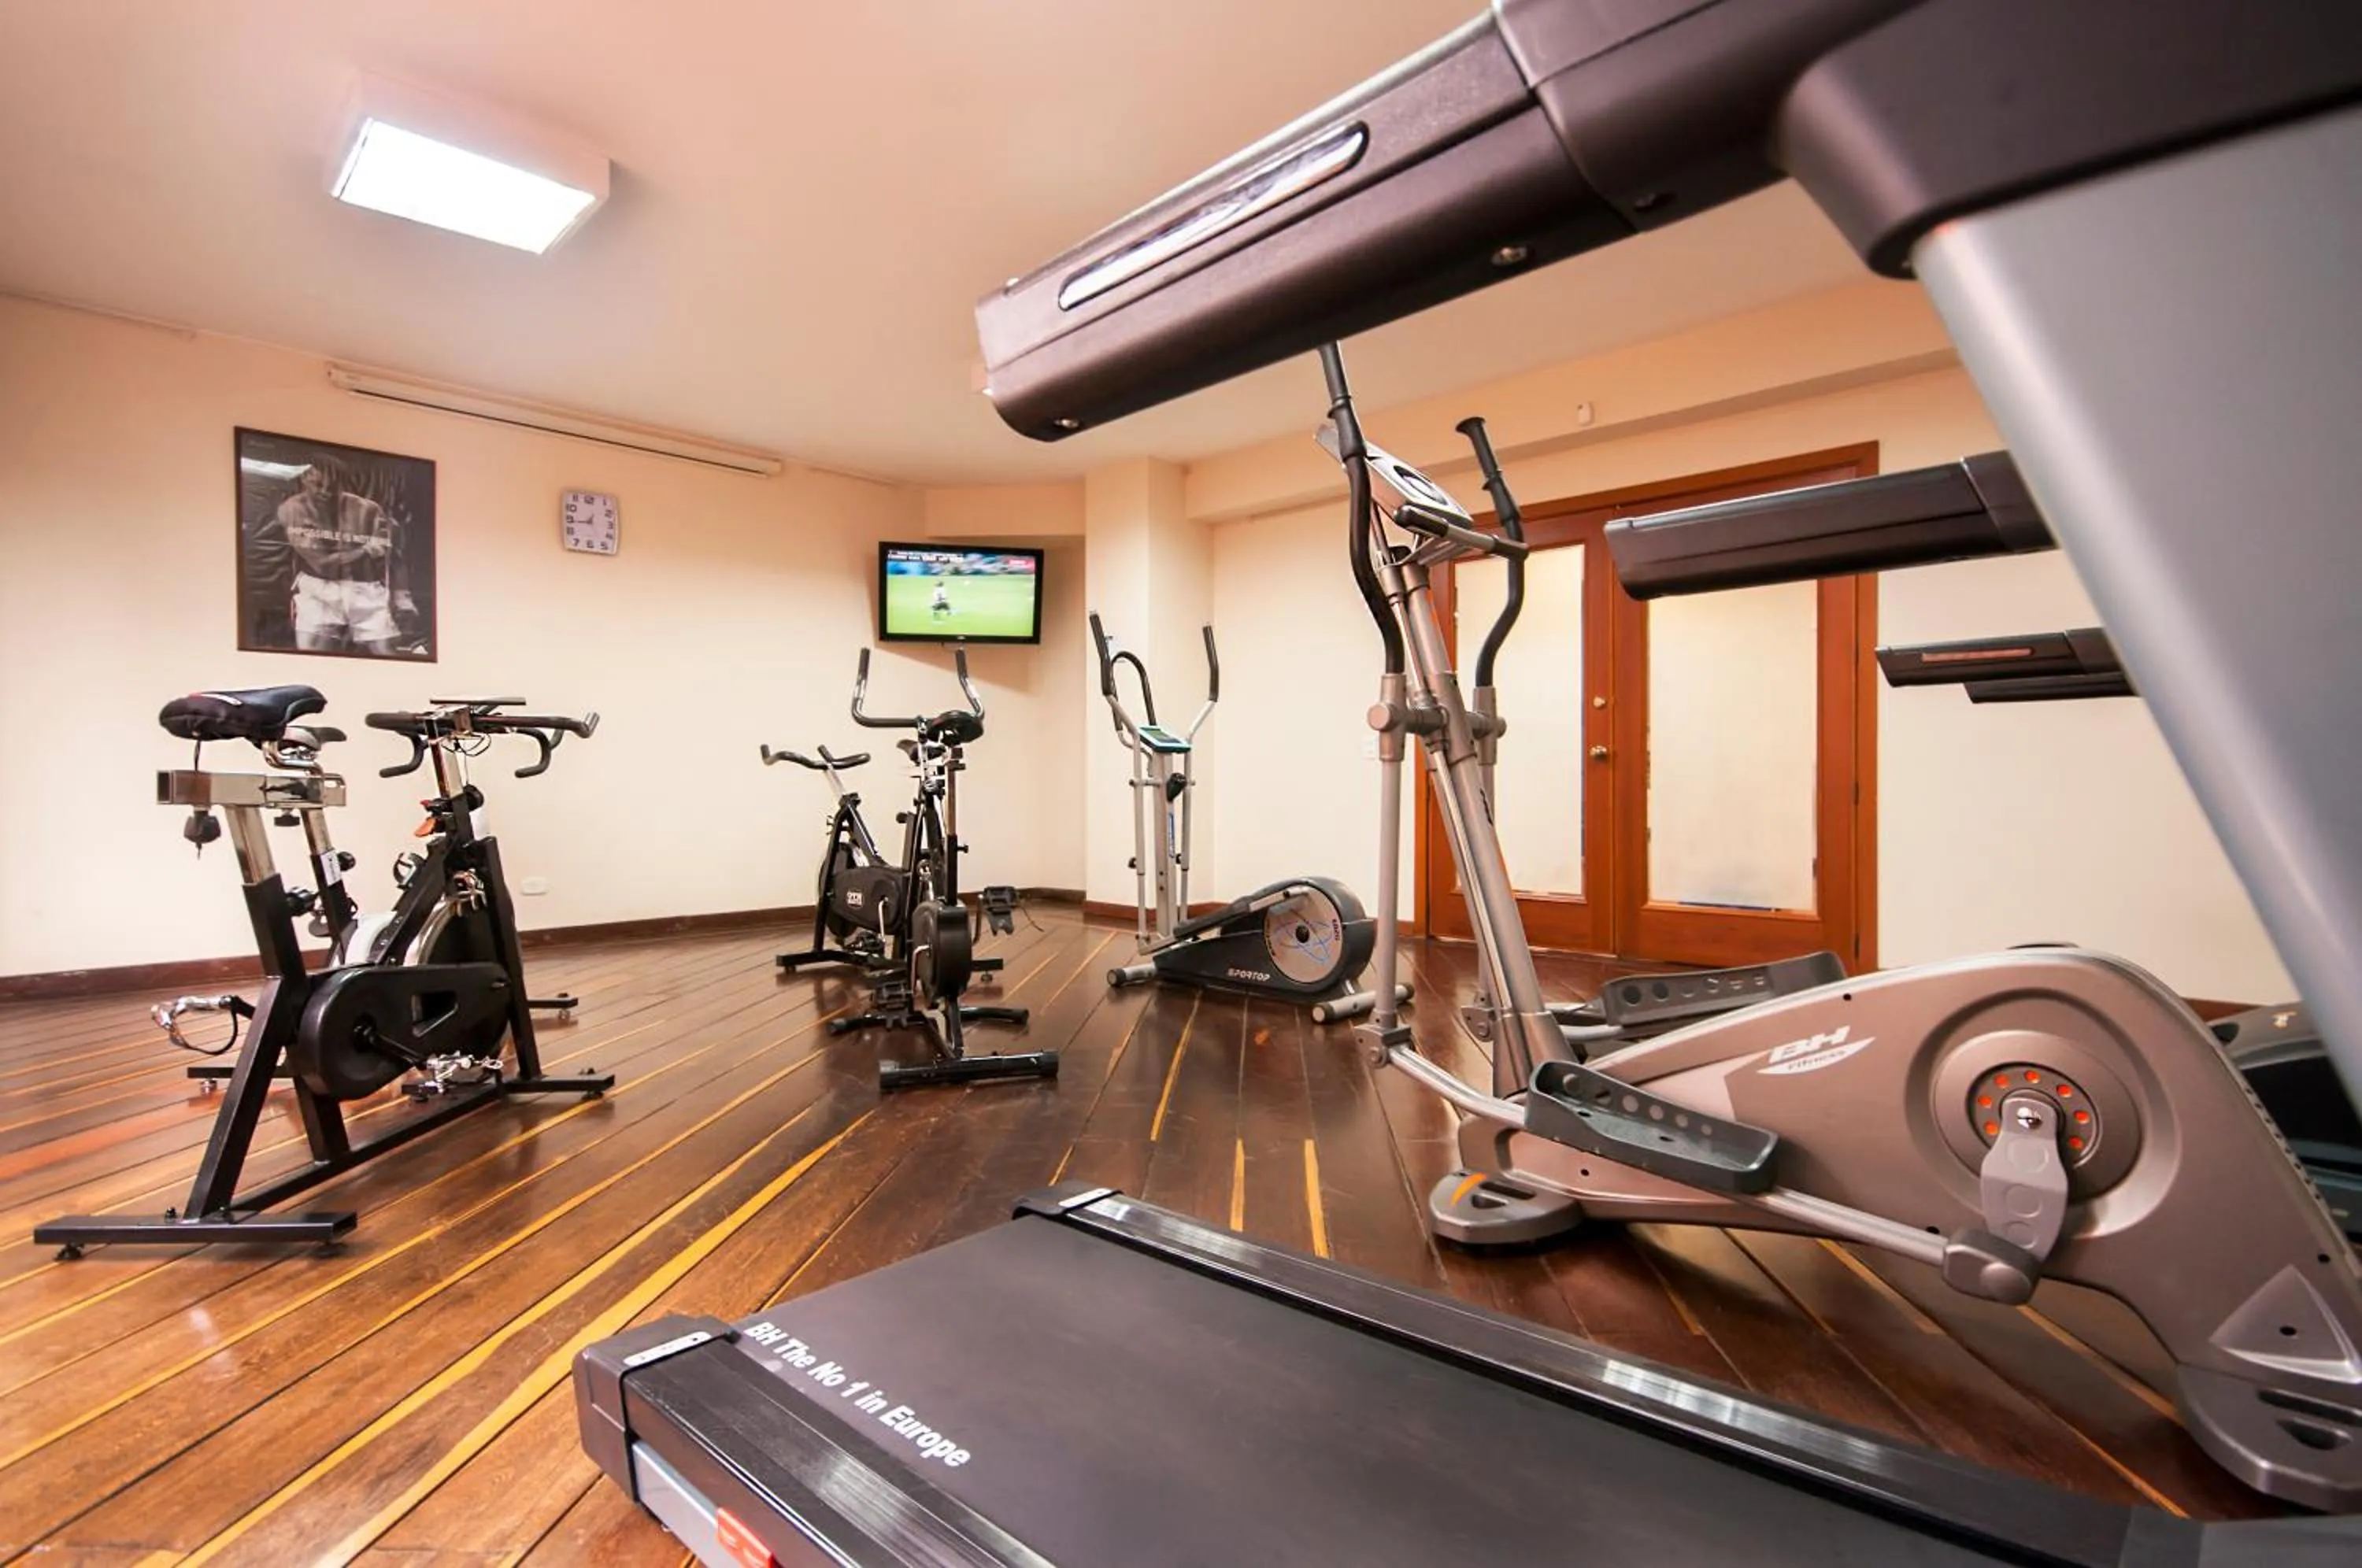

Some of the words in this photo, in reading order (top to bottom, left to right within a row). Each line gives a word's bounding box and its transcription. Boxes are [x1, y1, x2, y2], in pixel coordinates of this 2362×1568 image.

[565, 503, 577, 512] 10
[572, 538, 580, 547] 7
[744, 1322, 789, 1346] BH
[773, 1337, 816, 1368] The
[807, 1361, 846, 1387] No
[840, 1381, 869, 1397] 1
[853, 1391, 888, 1414] in
[879, 1405, 971, 1466] Europe
